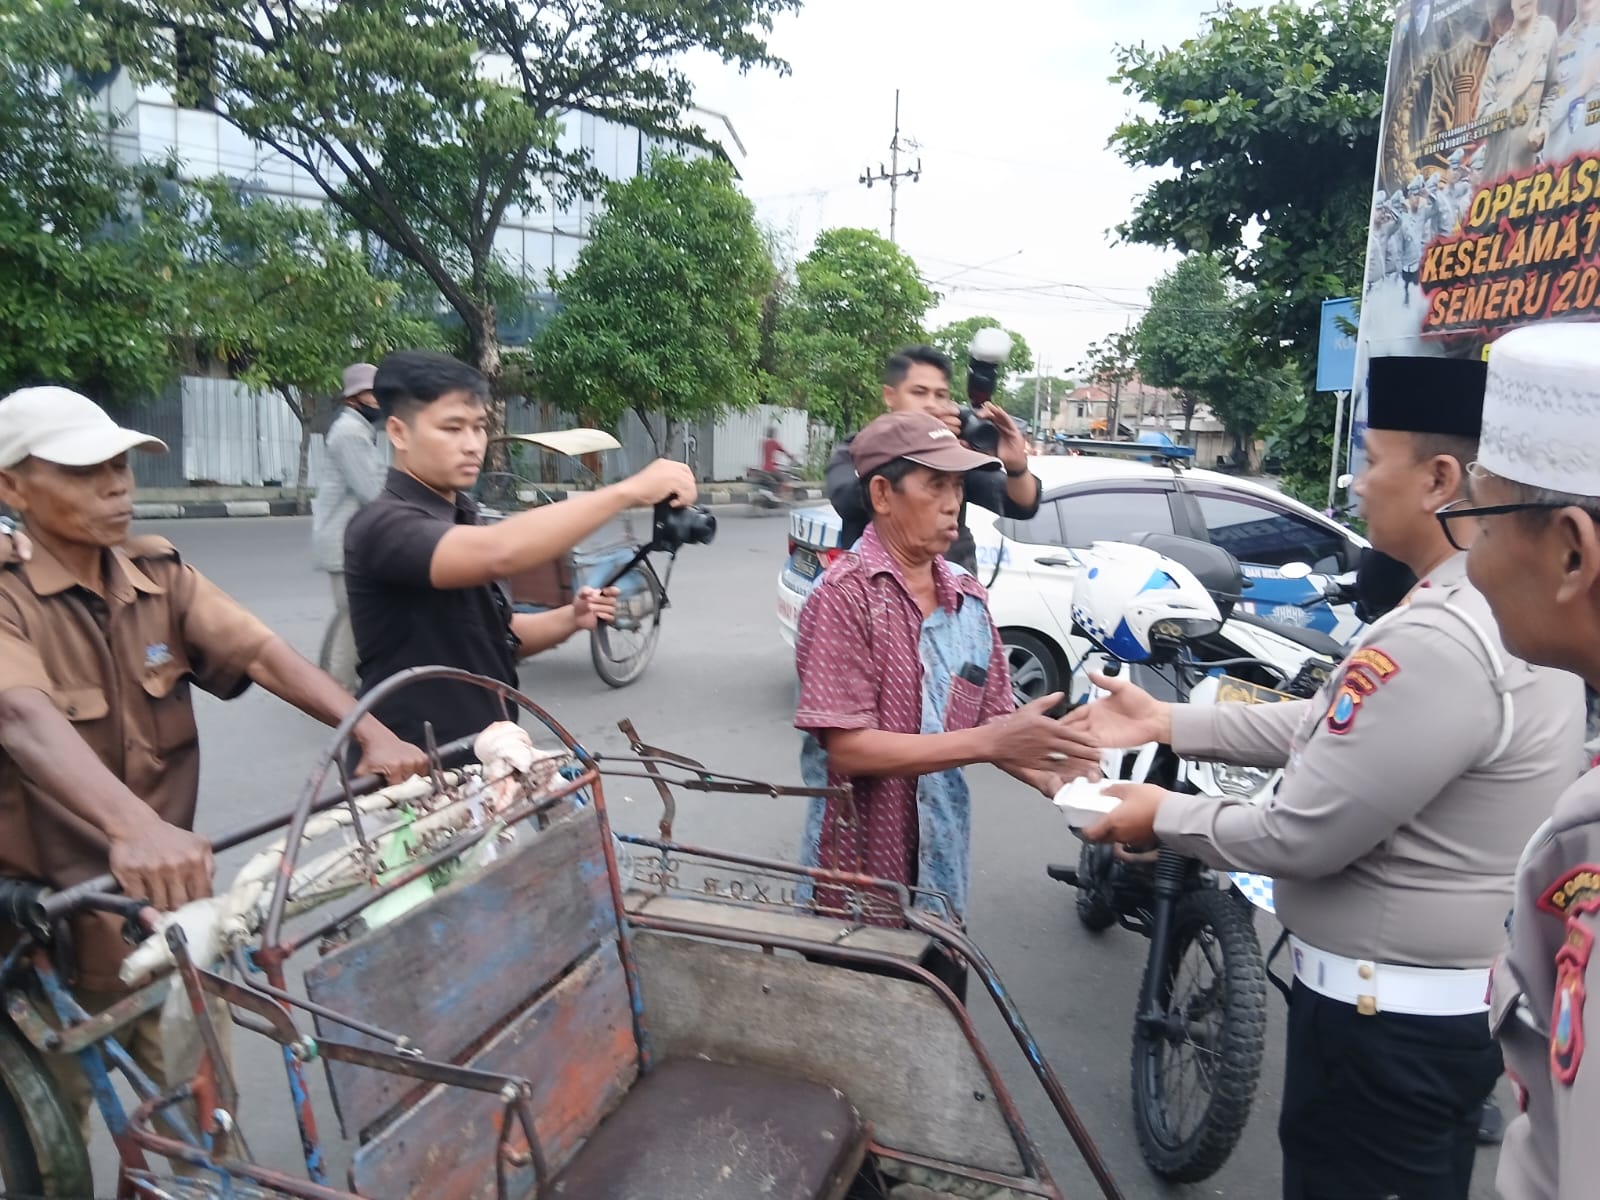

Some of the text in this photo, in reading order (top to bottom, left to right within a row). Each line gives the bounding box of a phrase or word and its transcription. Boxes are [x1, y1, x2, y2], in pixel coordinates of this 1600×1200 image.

[1421, 211, 1600, 283] KESELAMAT
[1430, 267, 1600, 326] SEMERU 20
